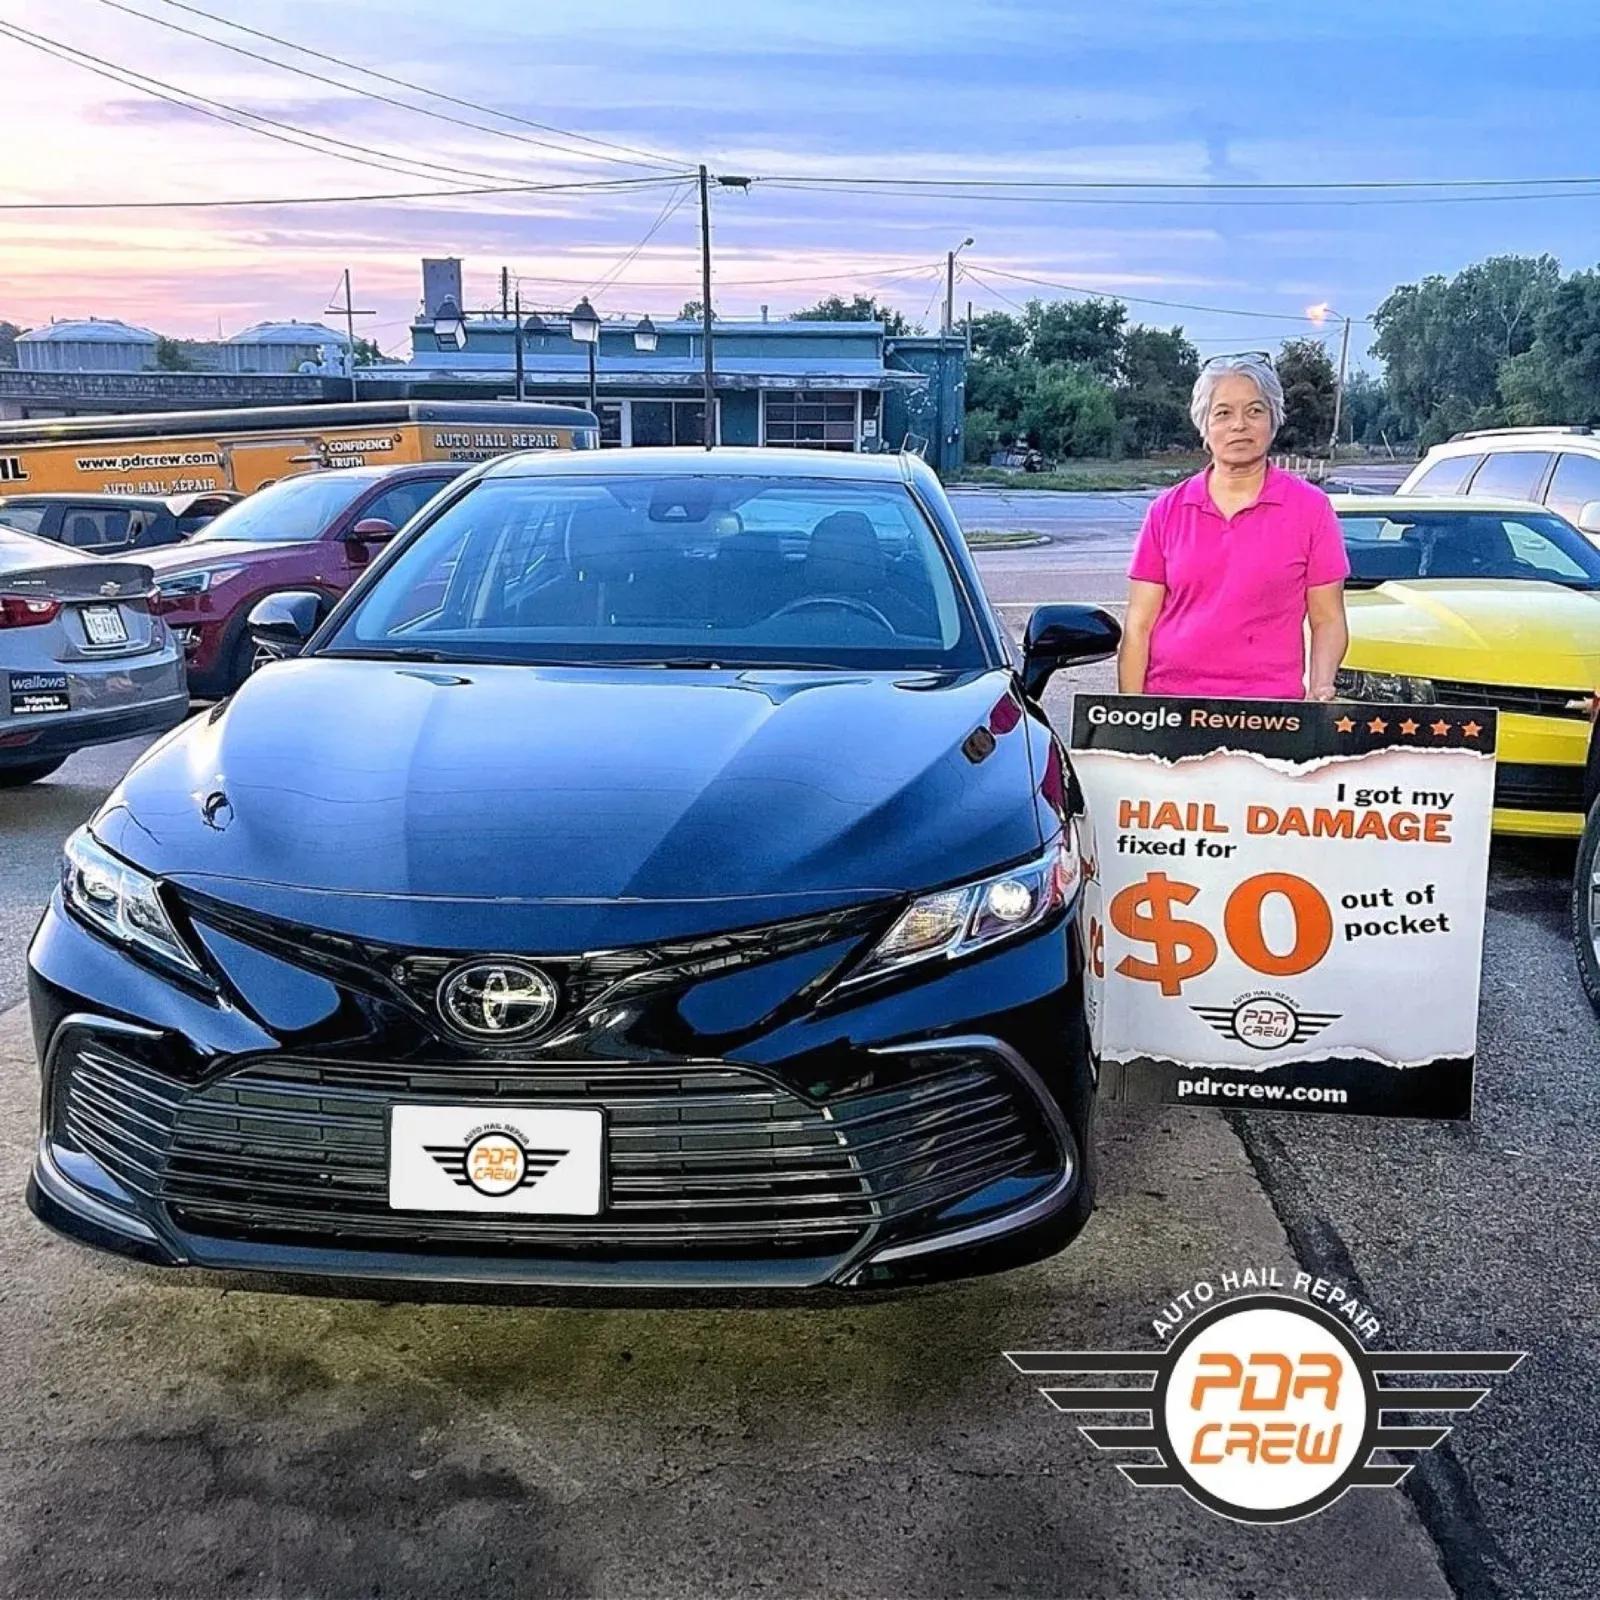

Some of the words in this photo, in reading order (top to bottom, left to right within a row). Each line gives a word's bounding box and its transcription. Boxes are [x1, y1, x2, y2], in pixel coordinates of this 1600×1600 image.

[328, 438, 392, 451] CONFIDENCE
[435, 433, 470, 447] AUTO
[474, 433, 508, 447] HAIL
[511, 433, 559, 448] REPAIR
[77, 452, 217, 471] www.pdrcrew.com
[330, 456, 364, 468] TRUTH
[103, 482, 134, 494] AUTO
[138, 480, 168, 494] HAIL
[11, 675, 66, 690] wallows
[1088, 705, 1182, 731] Google
[1190, 708, 1301, 732] Reviews
[1337, 783, 1345, 802] I
[1354, 786, 1402, 807] got
[1412, 790, 1454, 809] my
[1118, 799, 1229, 834] HAIL
[1246, 805, 1453, 843] DAMAGE
[1116, 835, 1186, 857] fixed
[1195, 838, 1237, 859] for
[1341, 888, 1394, 909] out
[1405, 884, 1435, 906] of
[1109, 872, 1334, 997] $0
[1344, 913, 1450, 941] pocket
[1242, 1009, 1290, 1026] PDR
[1242, 1025, 1288, 1038] CREW
[1177, 1077, 1348, 1103] pdrcrew.com
[464, 1126, 482, 1144] AUTO
[483, 1123, 502, 1131] HAIL
[504, 1123, 530, 1145] REPAIR
[474, 1147, 518, 1165] PDR
[473, 1167, 518, 1180] CREW
